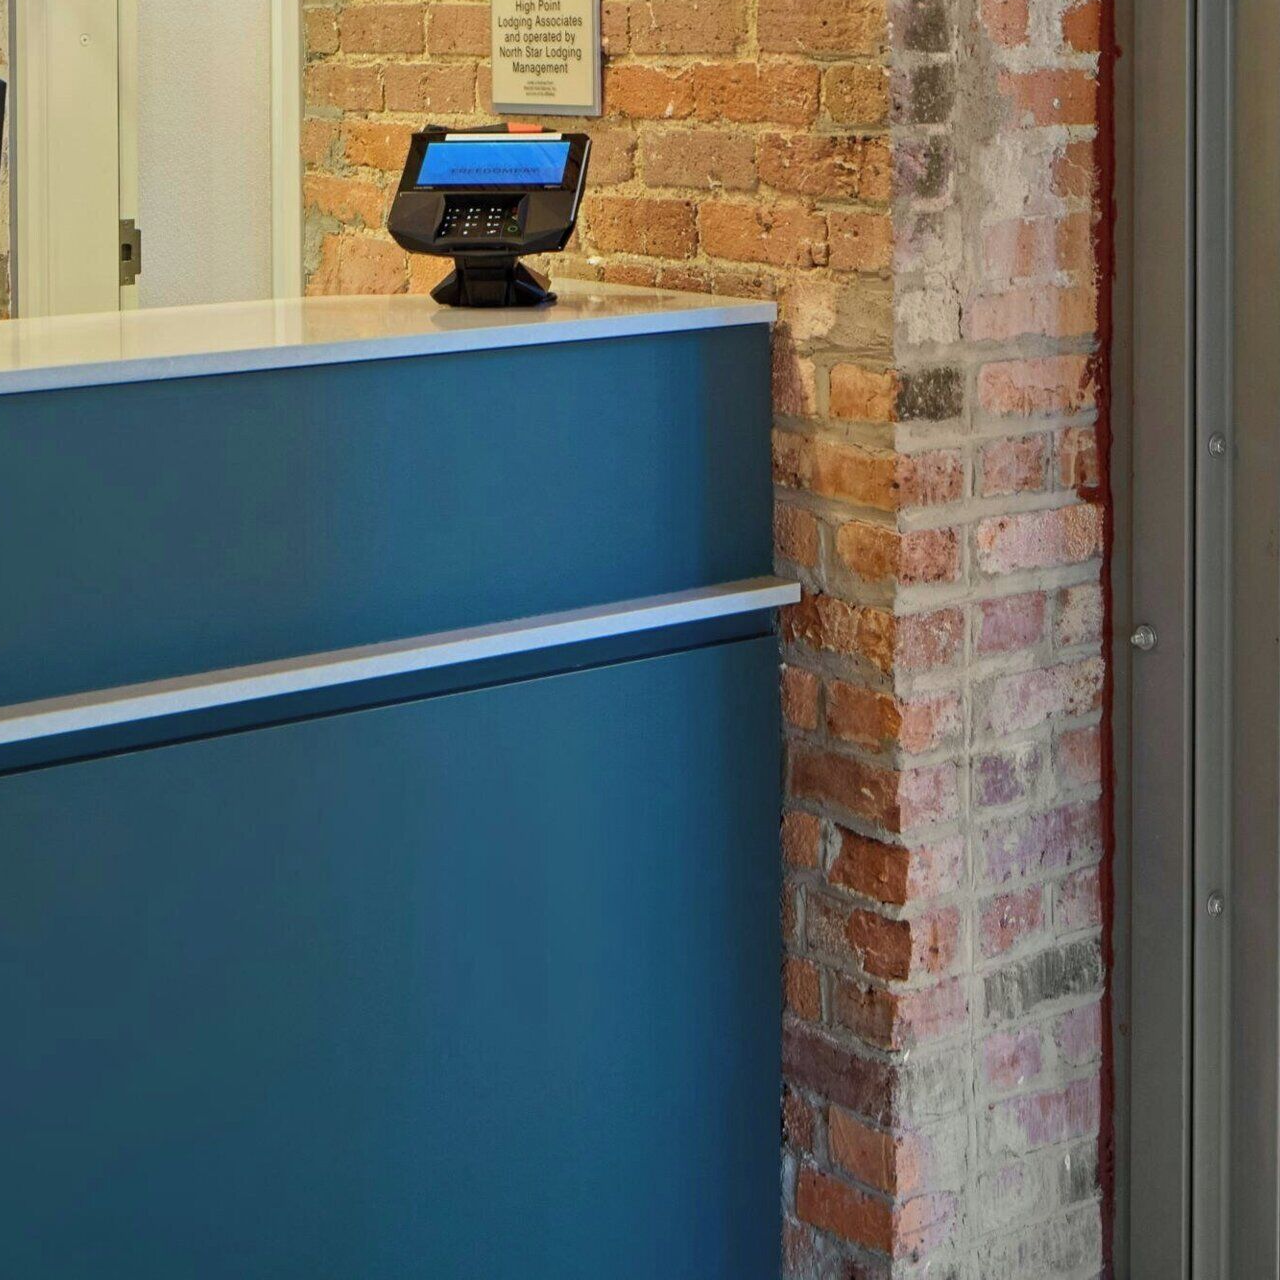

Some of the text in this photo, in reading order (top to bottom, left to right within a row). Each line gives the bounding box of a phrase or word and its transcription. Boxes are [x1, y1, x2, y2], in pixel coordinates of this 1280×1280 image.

[515, 0, 561, 15] High Point
[498, 15, 583, 30] Lodging Associates
[504, 30, 576, 45] and operated by
[499, 45, 582, 61] North Star Lodging
[512, 61, 568, 76] Management
